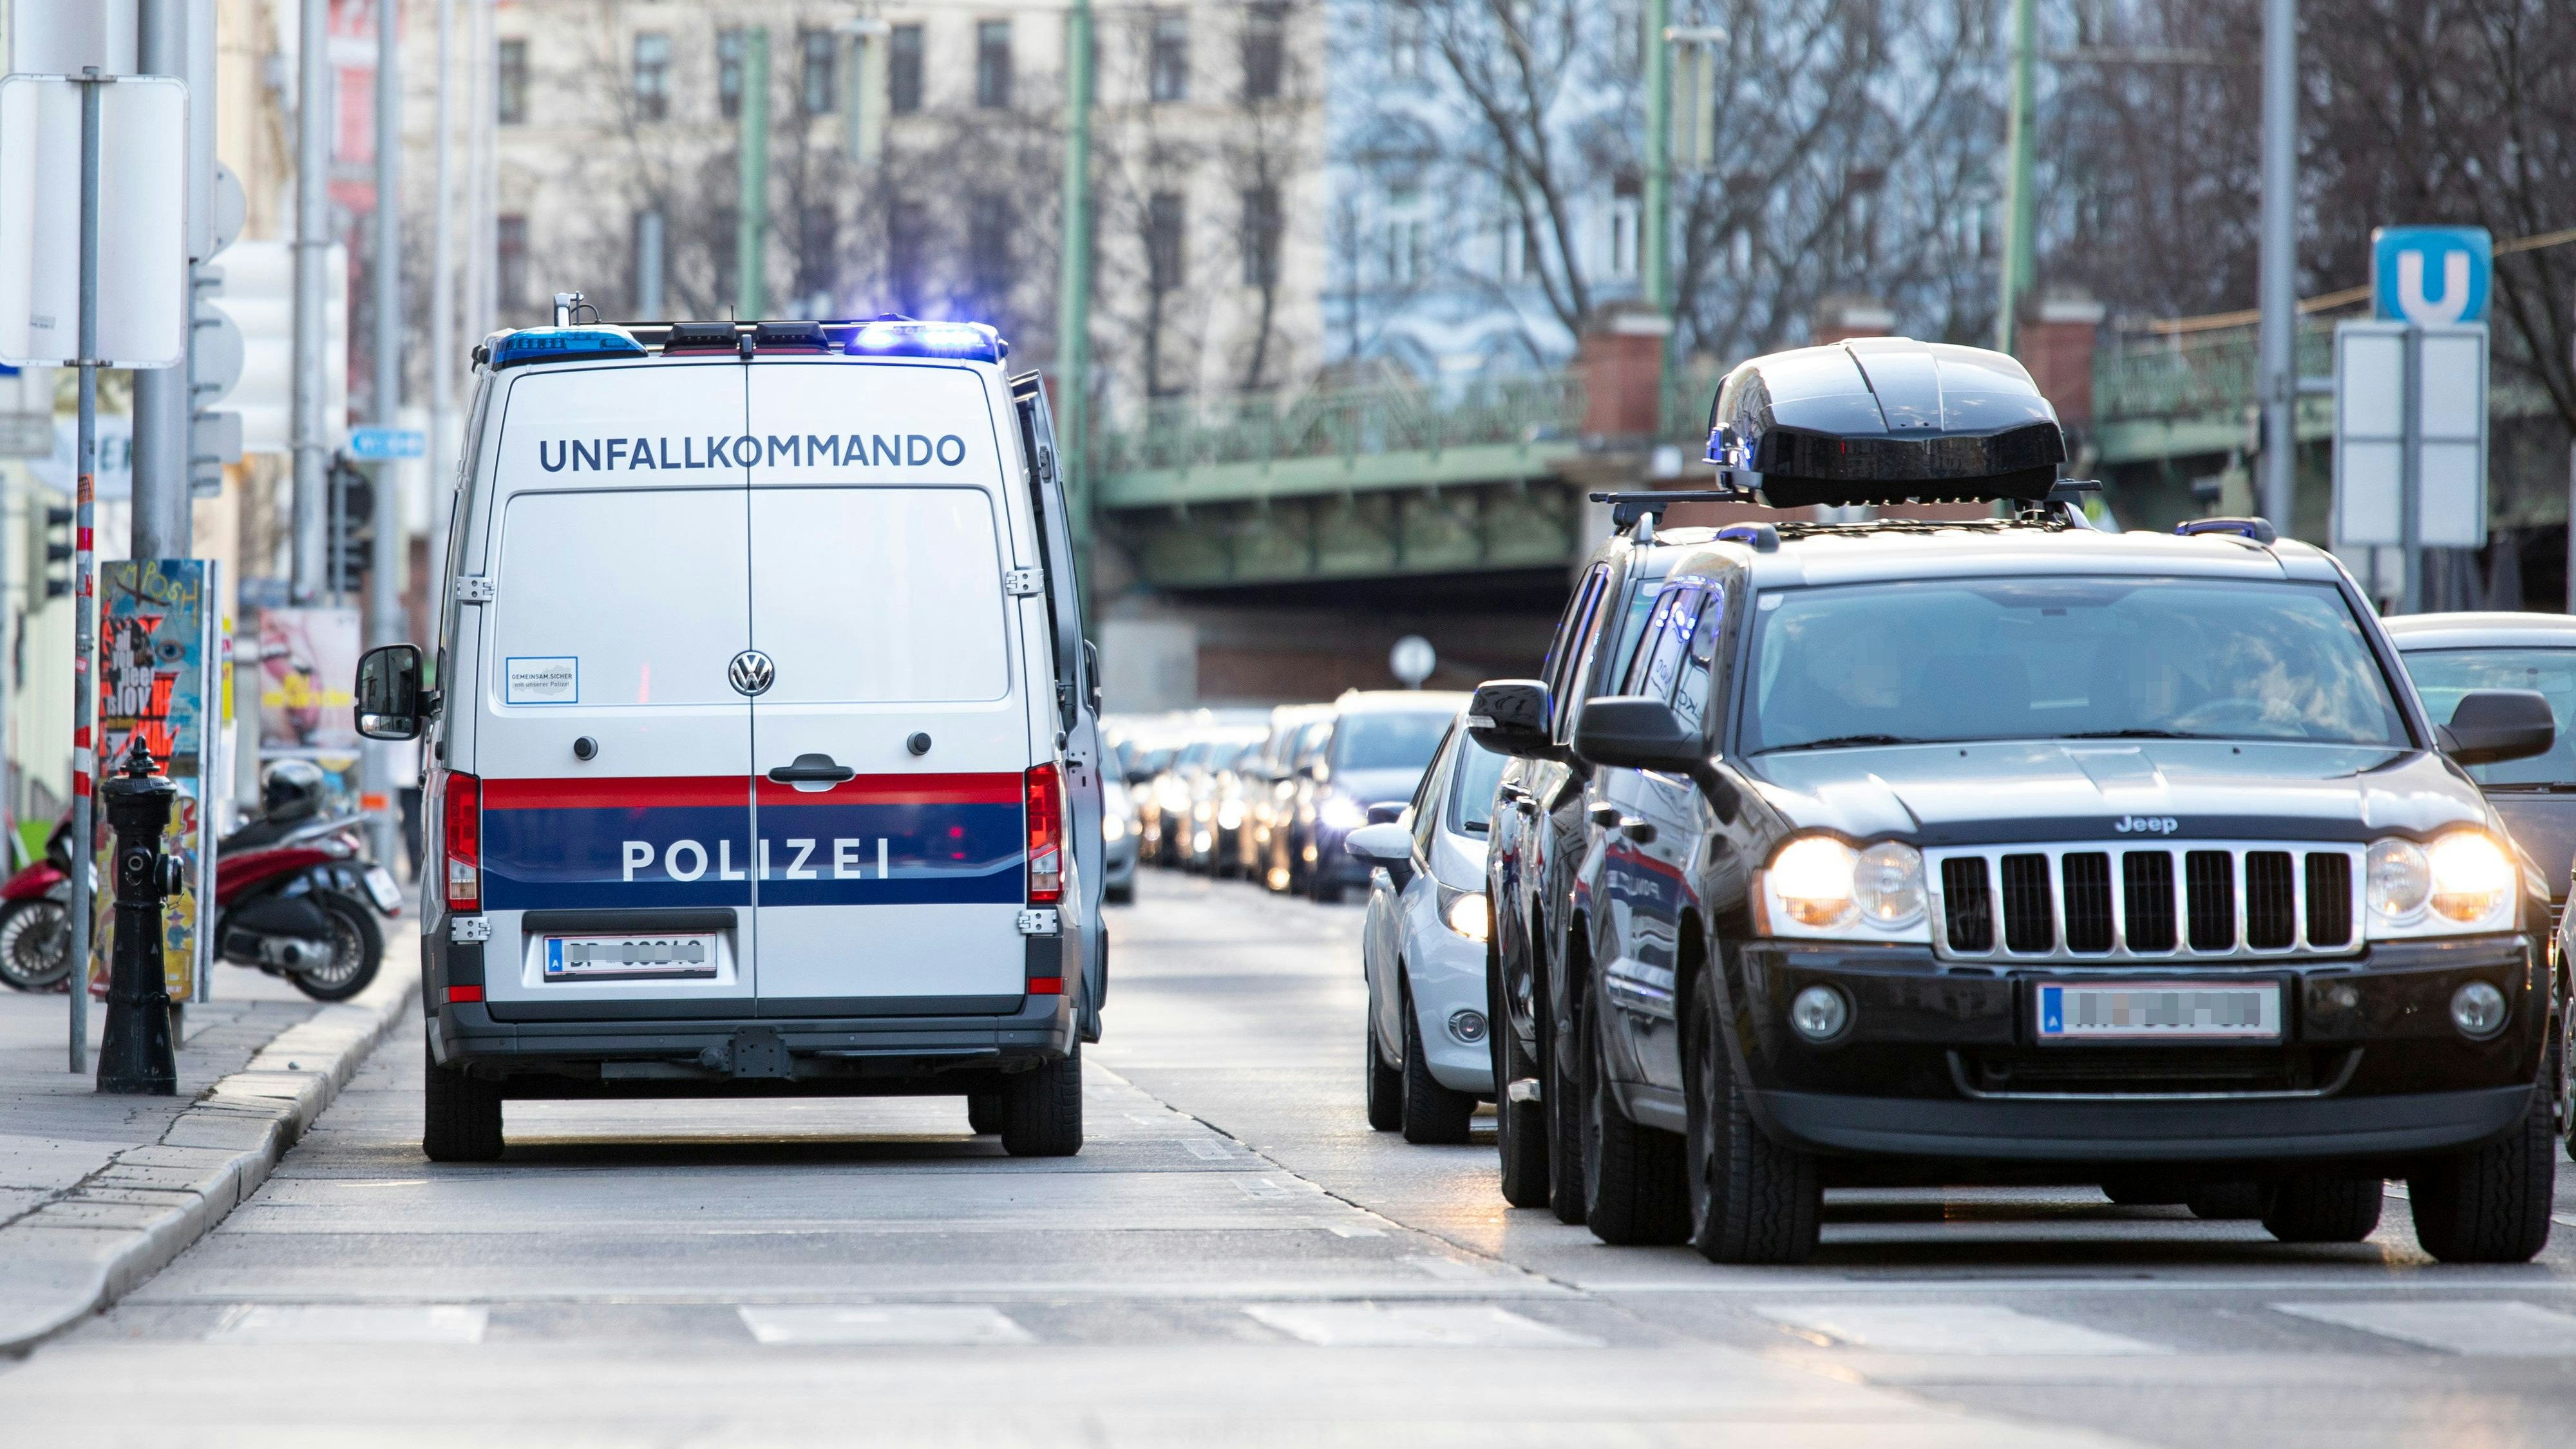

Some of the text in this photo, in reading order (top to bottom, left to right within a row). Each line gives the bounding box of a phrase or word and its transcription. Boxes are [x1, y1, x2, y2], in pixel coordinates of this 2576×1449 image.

[2398, 249, 2470, 323] U
[540, 434, 967, 473] UNFALLKOMMANDO
[731, 653, 772, 693] VW
[2114, 814, 2178, 835] Jeep
[623, 838, 889, 882] POLIZEI
[552, 959, 559, 967] A
